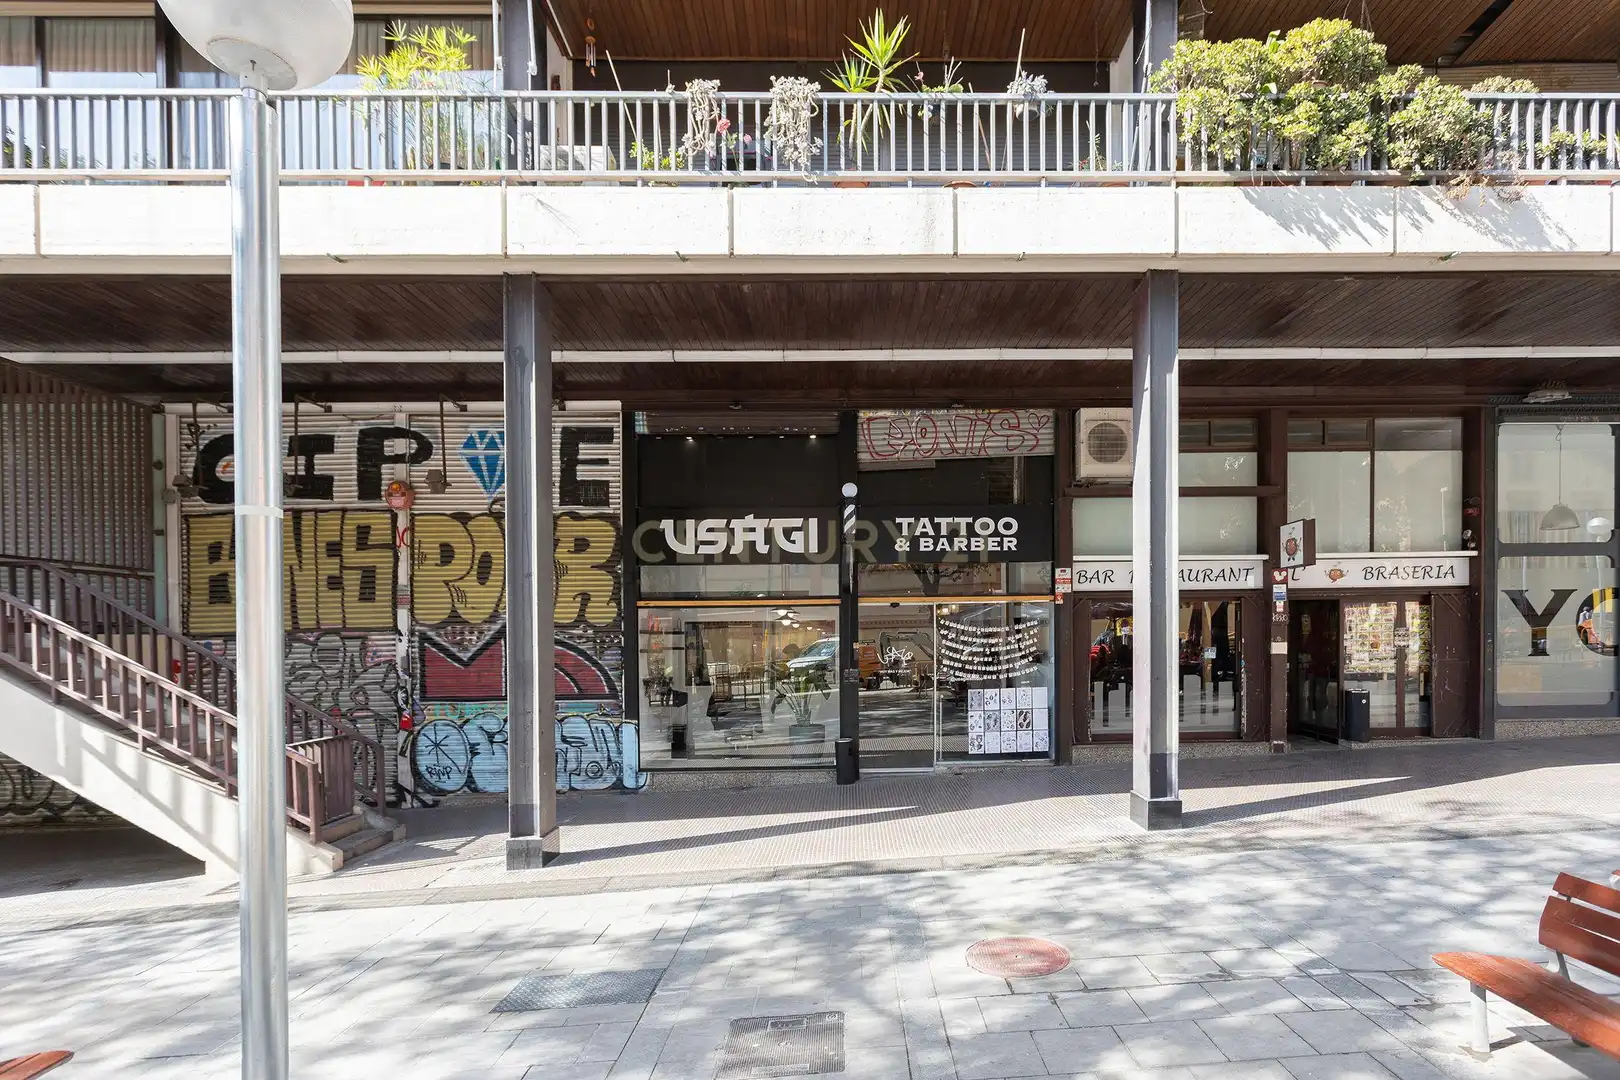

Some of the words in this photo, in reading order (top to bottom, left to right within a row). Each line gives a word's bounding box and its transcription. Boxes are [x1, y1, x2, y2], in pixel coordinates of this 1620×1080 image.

[895, 516, 1018, 536] TATTOO
[894, 537, 910, 551] &
[919, 537, 1018, 551] BARBER
[1076, 569, 1115, 584] BAR
[1362, 565, 1456, 581] BRASERIA
